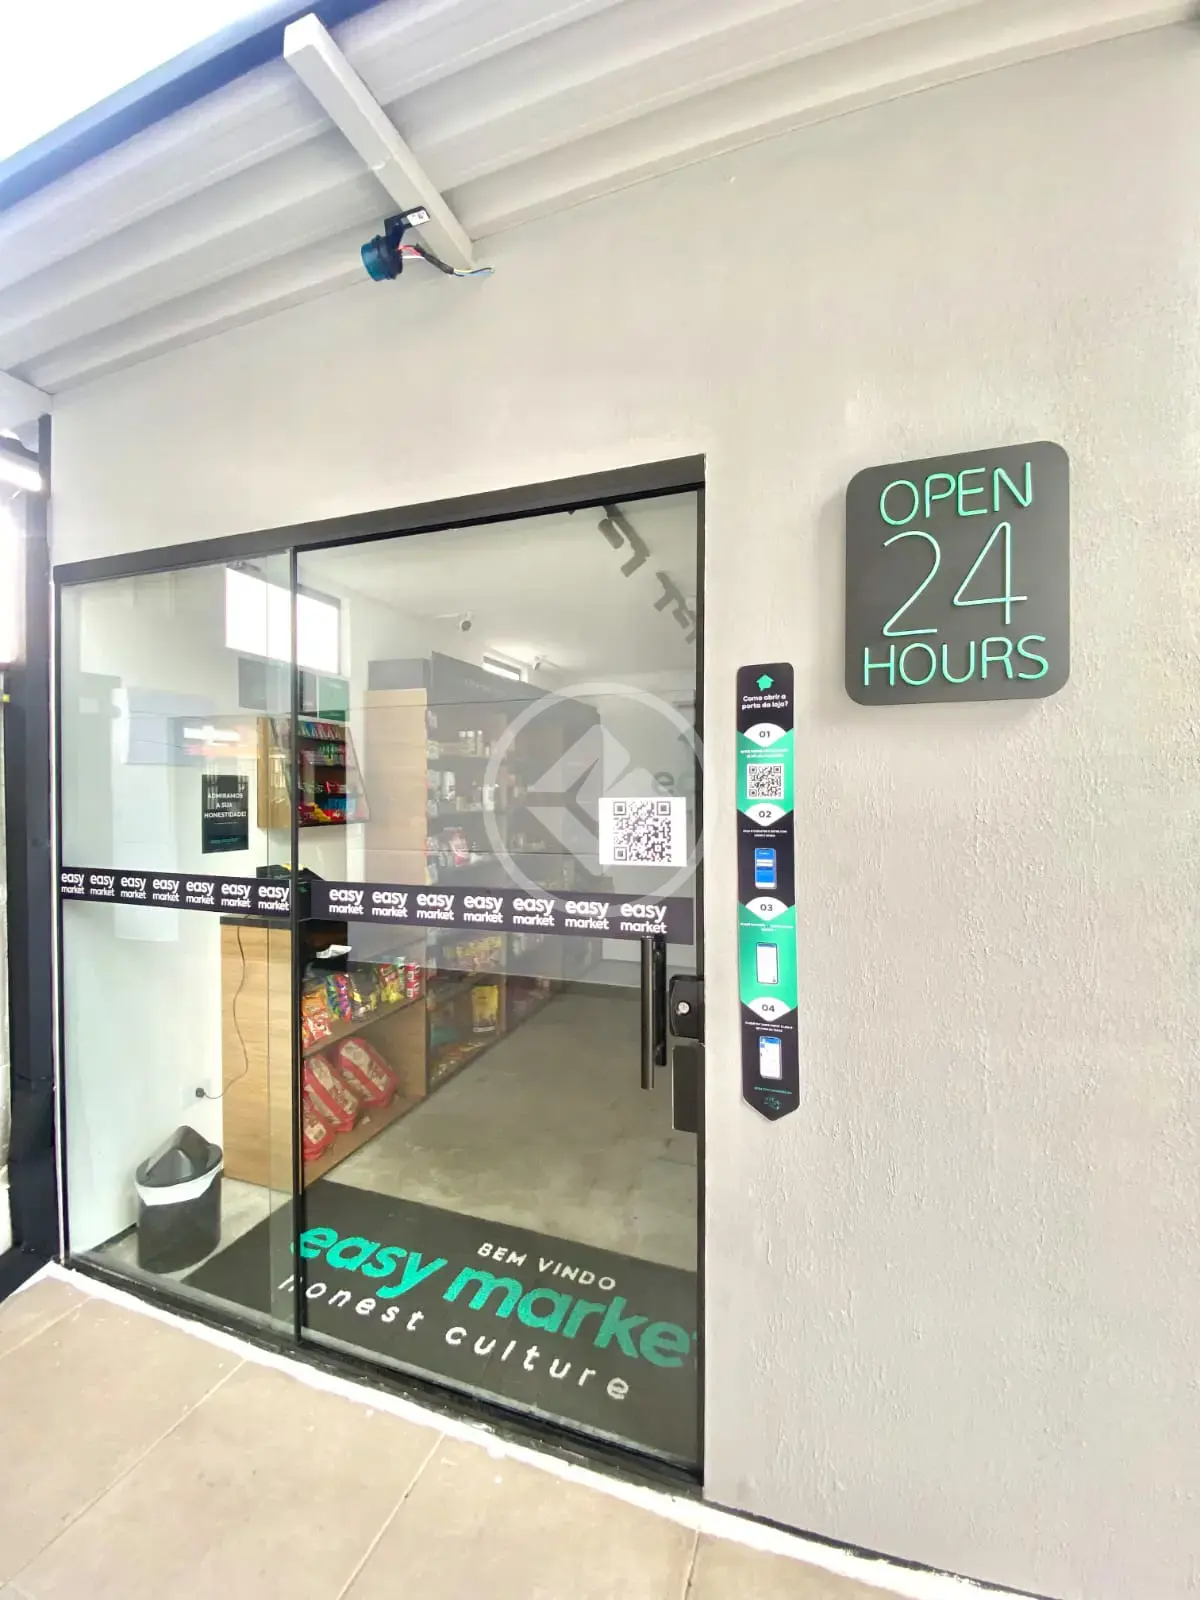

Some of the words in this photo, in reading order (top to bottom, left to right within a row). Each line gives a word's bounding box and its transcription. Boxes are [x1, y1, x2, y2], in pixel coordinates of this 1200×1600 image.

[879, 461, 1033, 526] OPEN
[883, 521, 1028, 637] 24
[863, 634, 1049, 687] HOURS
[741, 702, 761, 710] porta
[772, 700, 788, 709] loja?
[758, 730, 771, 738] 01
[758, 810, 772, 819] 02
[61, 872, 85, 886] easy
[90, 874, 115, 889] easy
[120, 875, 147, 891] easy
[152, 877, 180, 894] easy
[61, 885, 85, 895] market
[90, 887, 115, 897] market
[120, 889, 147, 900] market
[186, 879, 214, 896] easy
[221, 882, 251, 899] easy
[258, 884, 290, 902] easy
[152, 892, 180, 902] market
[186, 894, 215, 905] market
[220, 897, 251, 908] market
[329, 887, 364, 906] easy
[372, 888, 408, 908] easy
[416, 890, 455, 912] easy
[464, 893, 503, 914] easy
[257, 900, 290, 911] market
[329, 903, 364, 916] market
[371, 905, 408, 919] market
[513, 896, 555, 918] easy
[565, 899, 610, 919] easy
[620, 901, 667, 924] easy
[759, 903, 773, 912] 03
[416, 908, 455, 921] market
[463, 911, 503, 924] market
[512, 913, 555, 927] market
[564, 917, 610, 930] market
[620, 920, 667, 934] market
[761, 1004, 775, 1013] 04
[476, 1242, 527, 1268] BEM
[538, 1256, 616, 1291] VINDO
[290, 1226, 448, 1299] easy
[442, 1265, 698, 1368] marke
[445, 1325, 630, 1400] culture
